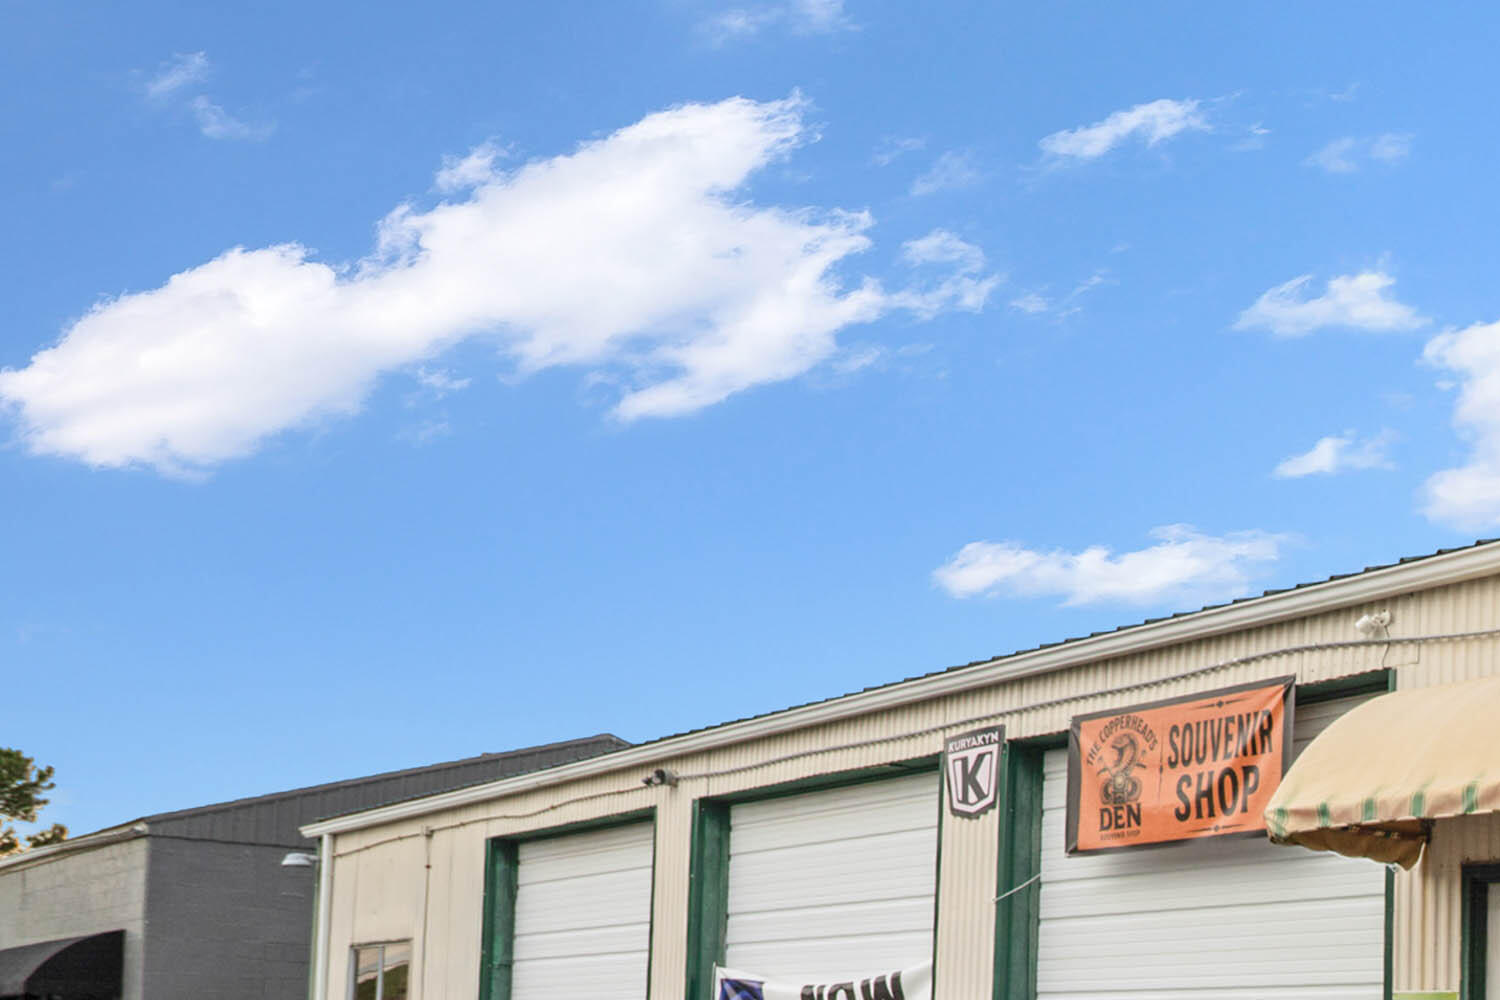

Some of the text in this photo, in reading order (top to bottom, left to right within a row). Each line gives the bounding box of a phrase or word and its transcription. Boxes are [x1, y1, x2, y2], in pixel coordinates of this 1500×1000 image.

[947, 731, 999, 753] KURYAKYN
[1167, 709, 1273, 770] SOUVENIR
[1174, 765, 1260, 823] SHOP
[1099, 803, 1142, 832] DEN
